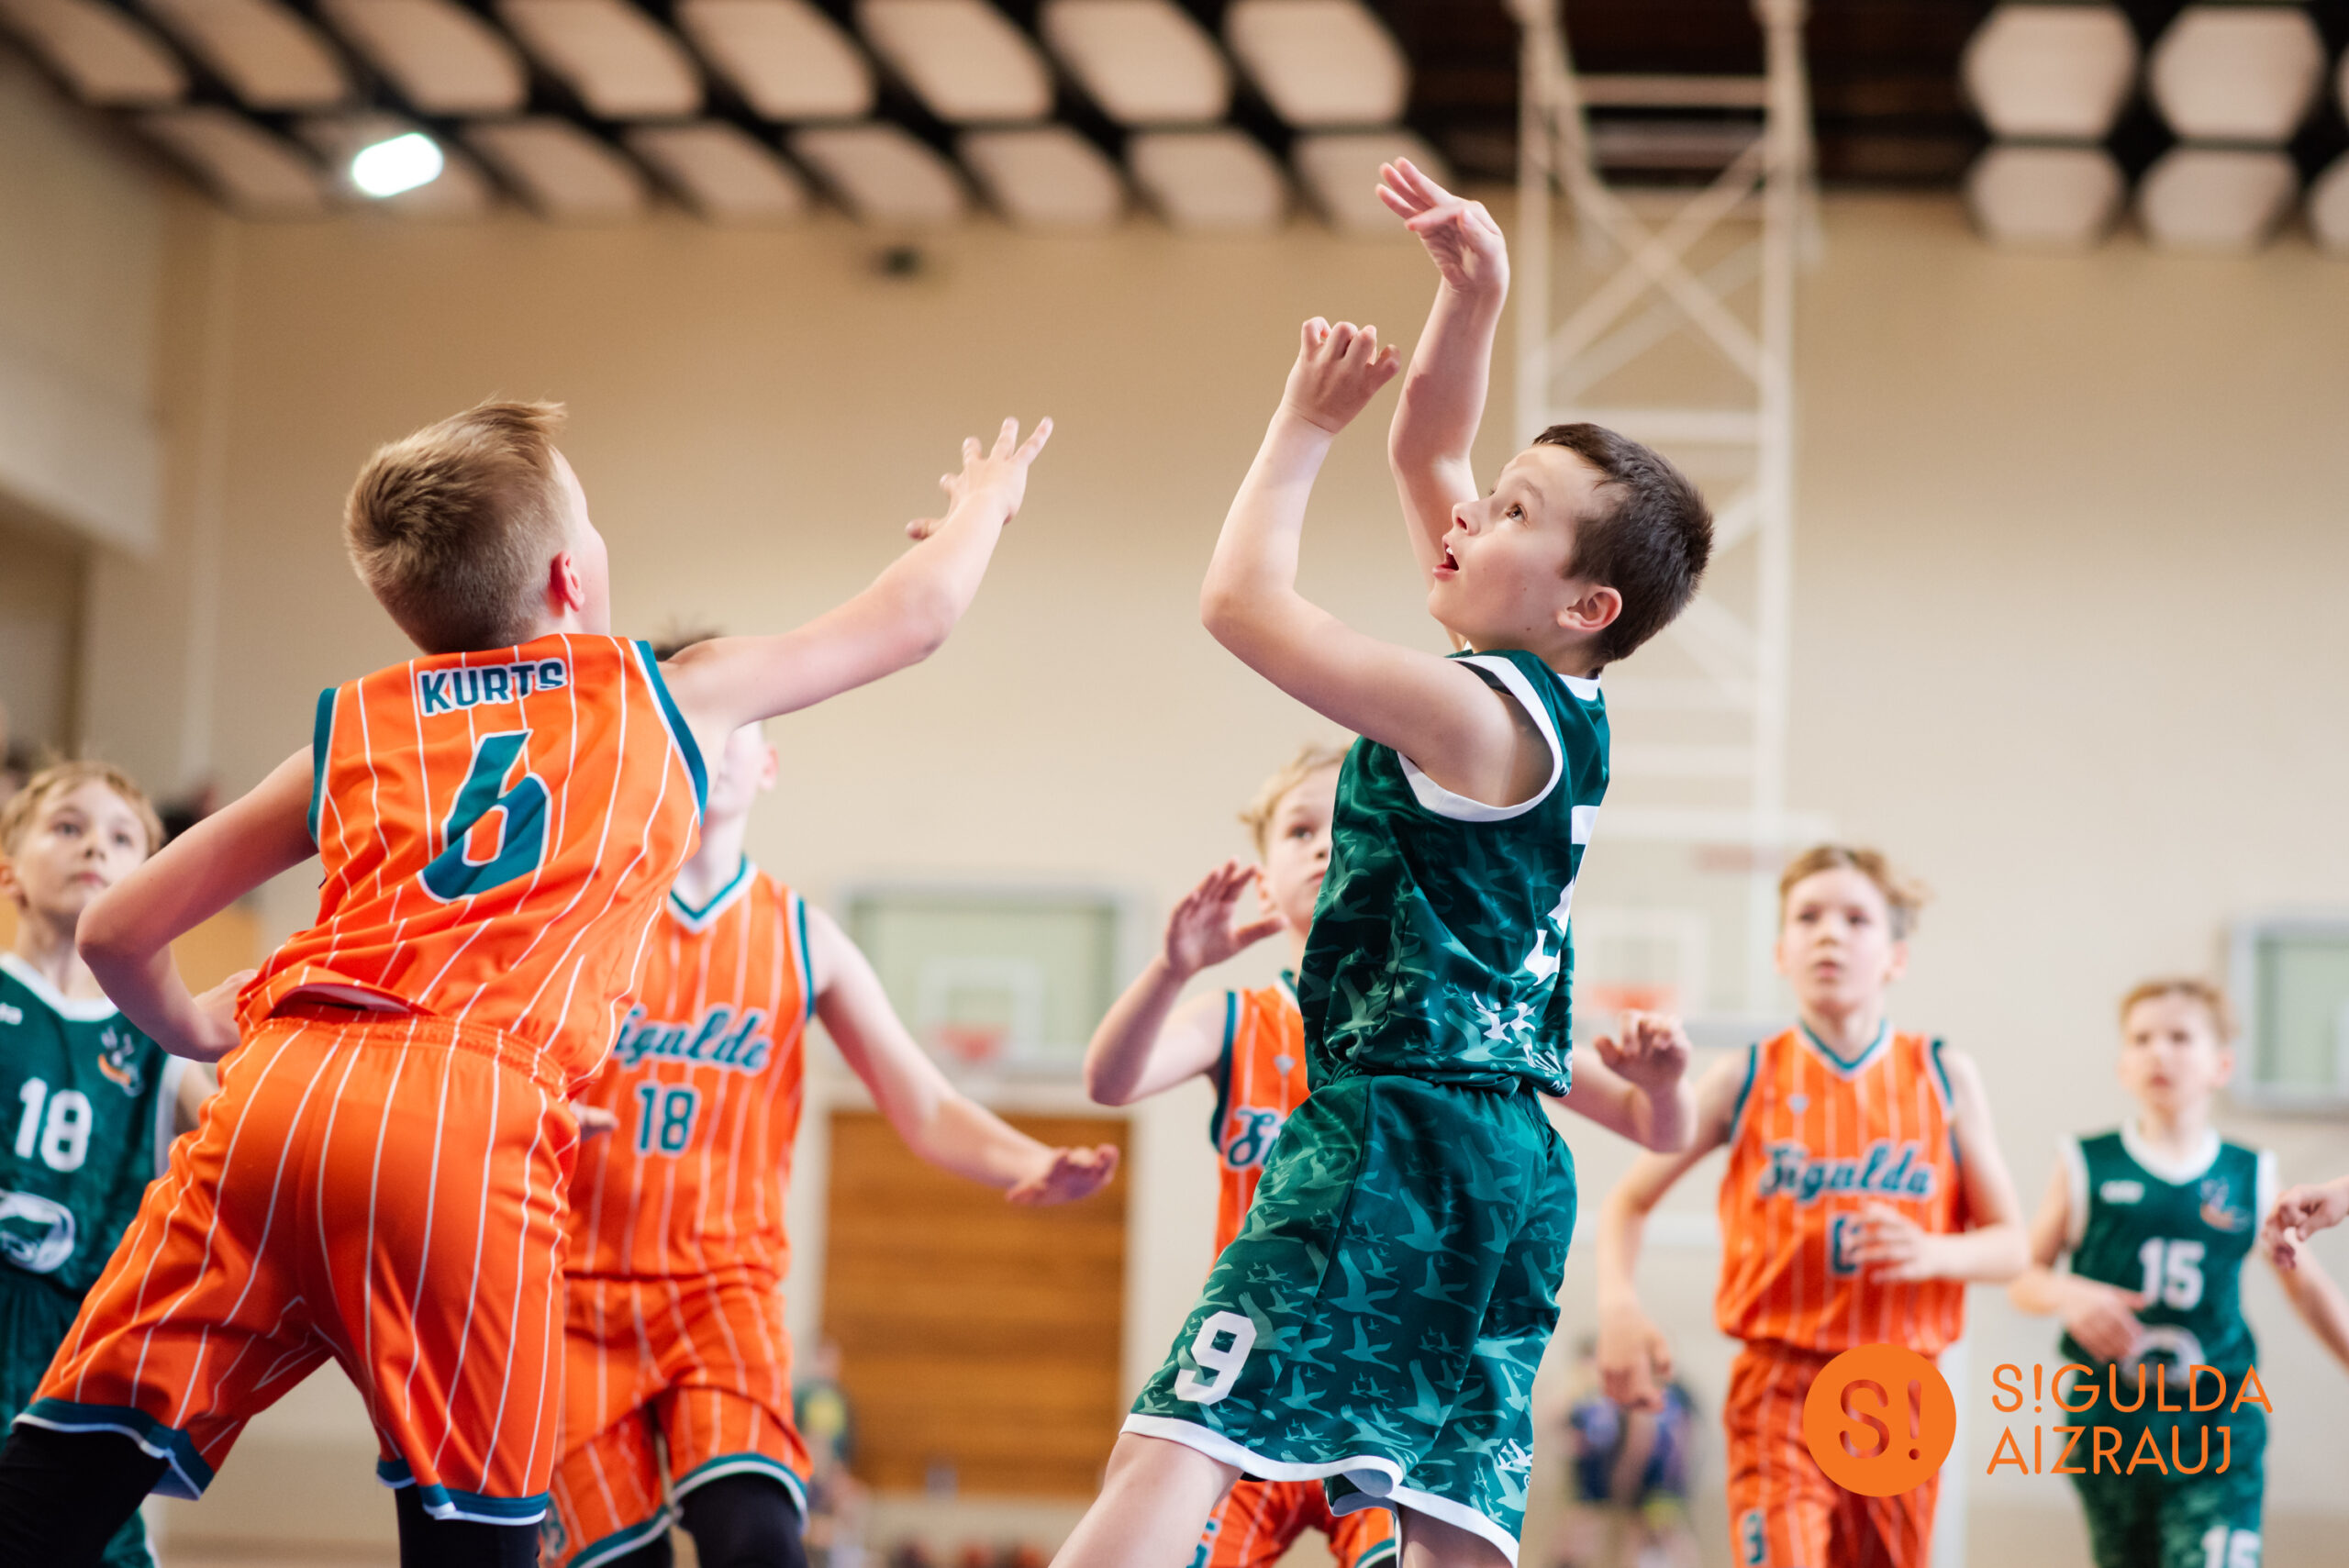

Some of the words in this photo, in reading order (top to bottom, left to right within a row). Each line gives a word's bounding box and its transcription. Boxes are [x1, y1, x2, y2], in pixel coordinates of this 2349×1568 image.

[418, 659, 568, 717] KURTS
[417, 728, 552, 904] 6
[613, 1004, 772, 1076] igulda
[15, 1076, 93, 1173] 18
[635, 1081, 700, 1156] 18
[2139, 1237, 2205, 1311] 15
[1174, 1310, 1257, 1407] 9
